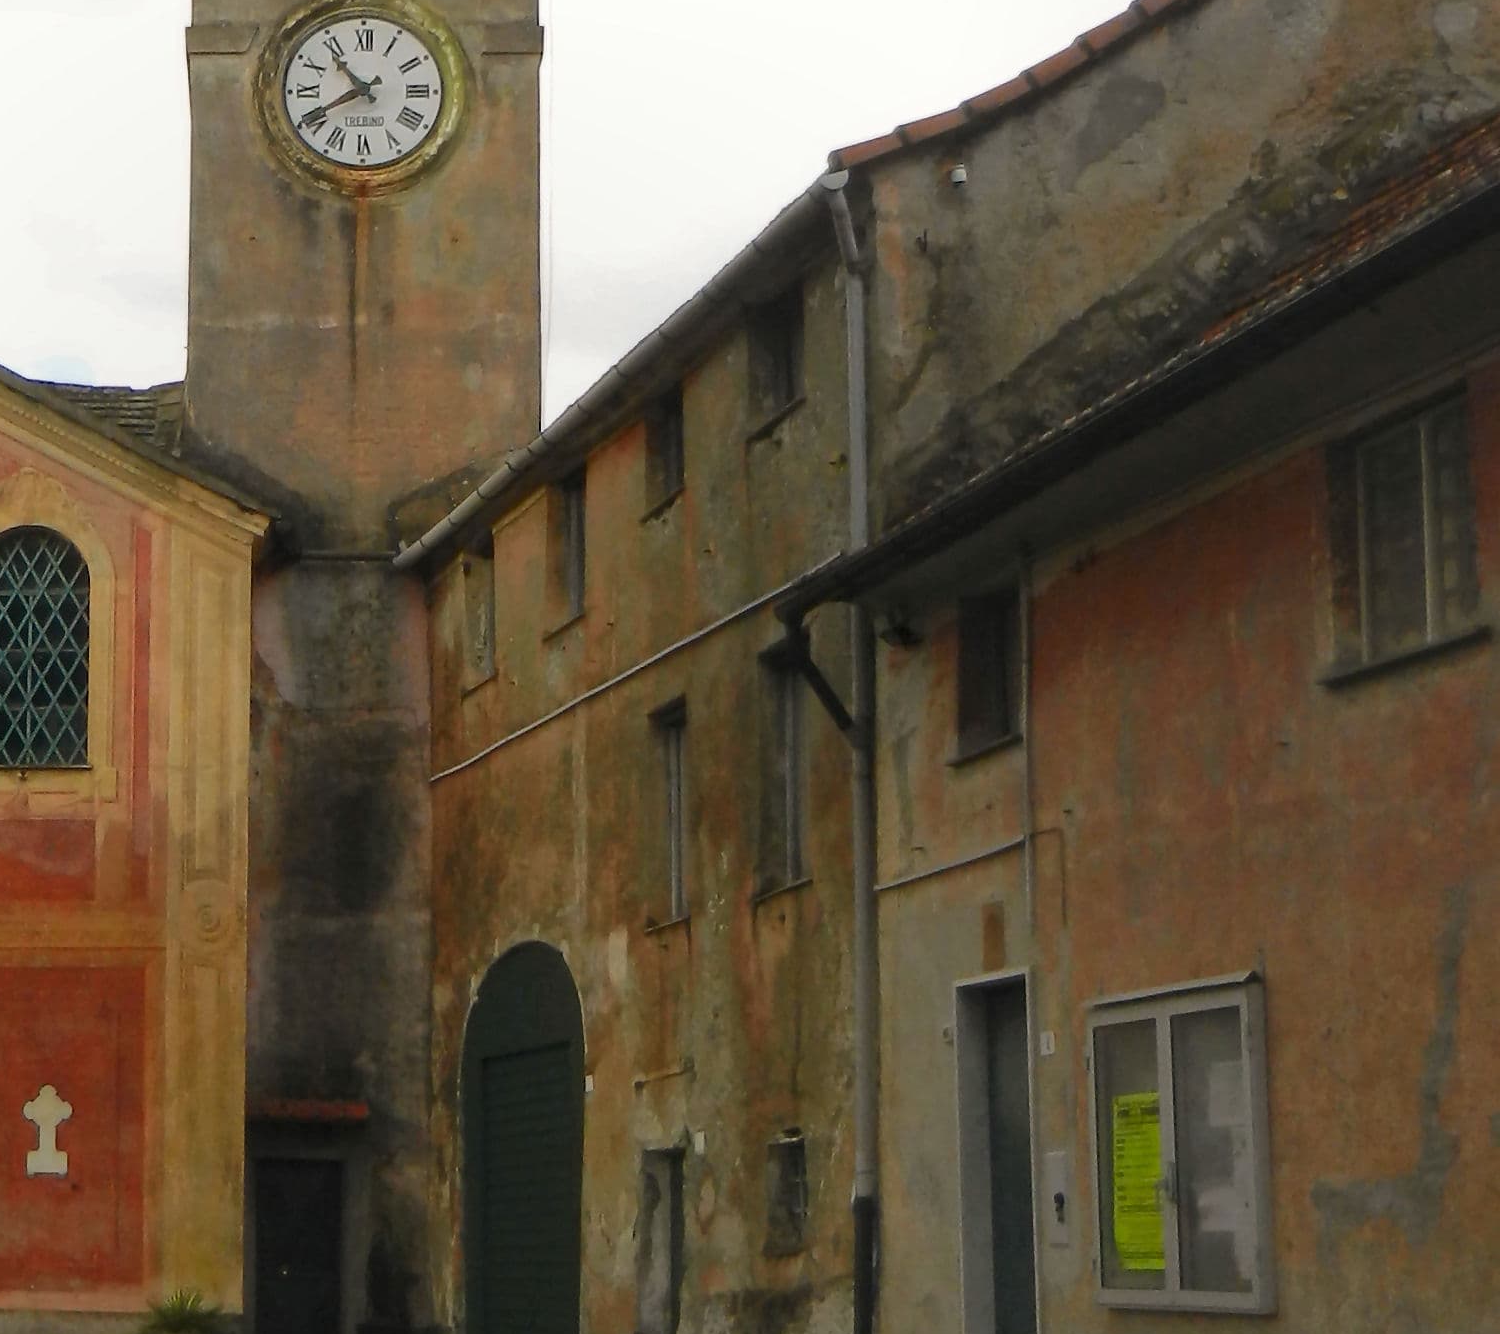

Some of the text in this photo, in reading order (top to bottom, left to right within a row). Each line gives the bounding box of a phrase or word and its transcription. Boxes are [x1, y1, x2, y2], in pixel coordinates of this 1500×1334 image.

[355, 29, 374, 51] XII
[303, 57, 327, 77] X
[297, 83, 320, 98] IX
[406, 84, 429, 99] III
[345, 116, 384, 127] TREBINO
[357, 134, 371, 155] VI
[385, 129, 400, 149] V
